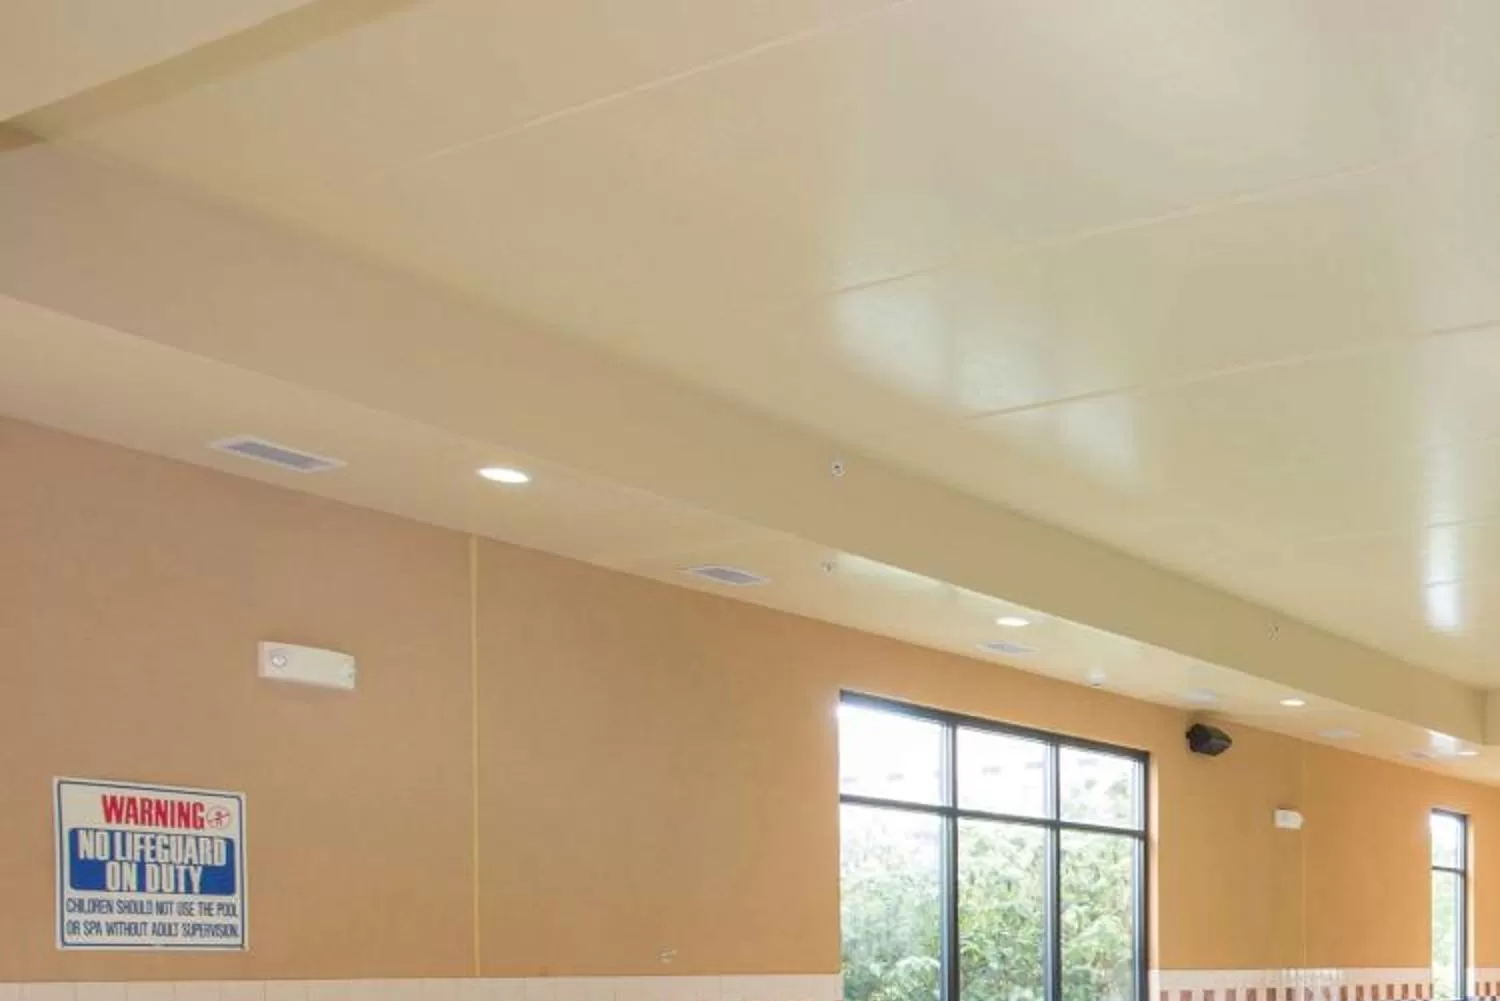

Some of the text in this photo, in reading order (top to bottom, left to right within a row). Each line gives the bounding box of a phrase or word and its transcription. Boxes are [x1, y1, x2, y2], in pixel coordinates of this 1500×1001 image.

[101, 795, 205, 830] WARNING
[78, 830, 227, 867] NO LIFEGUARD
[105, 861, 203, 894] ON DUTY
[66, 897, 238, 917] CHILDREN SHOULD NOT USE THE POOL
[66, 919, 81, 936] OR
[83, 920, 103, 937] SPA
[105, 921, 148, 937] WITHOUT
[151, 922, 179, 937] ADULT
